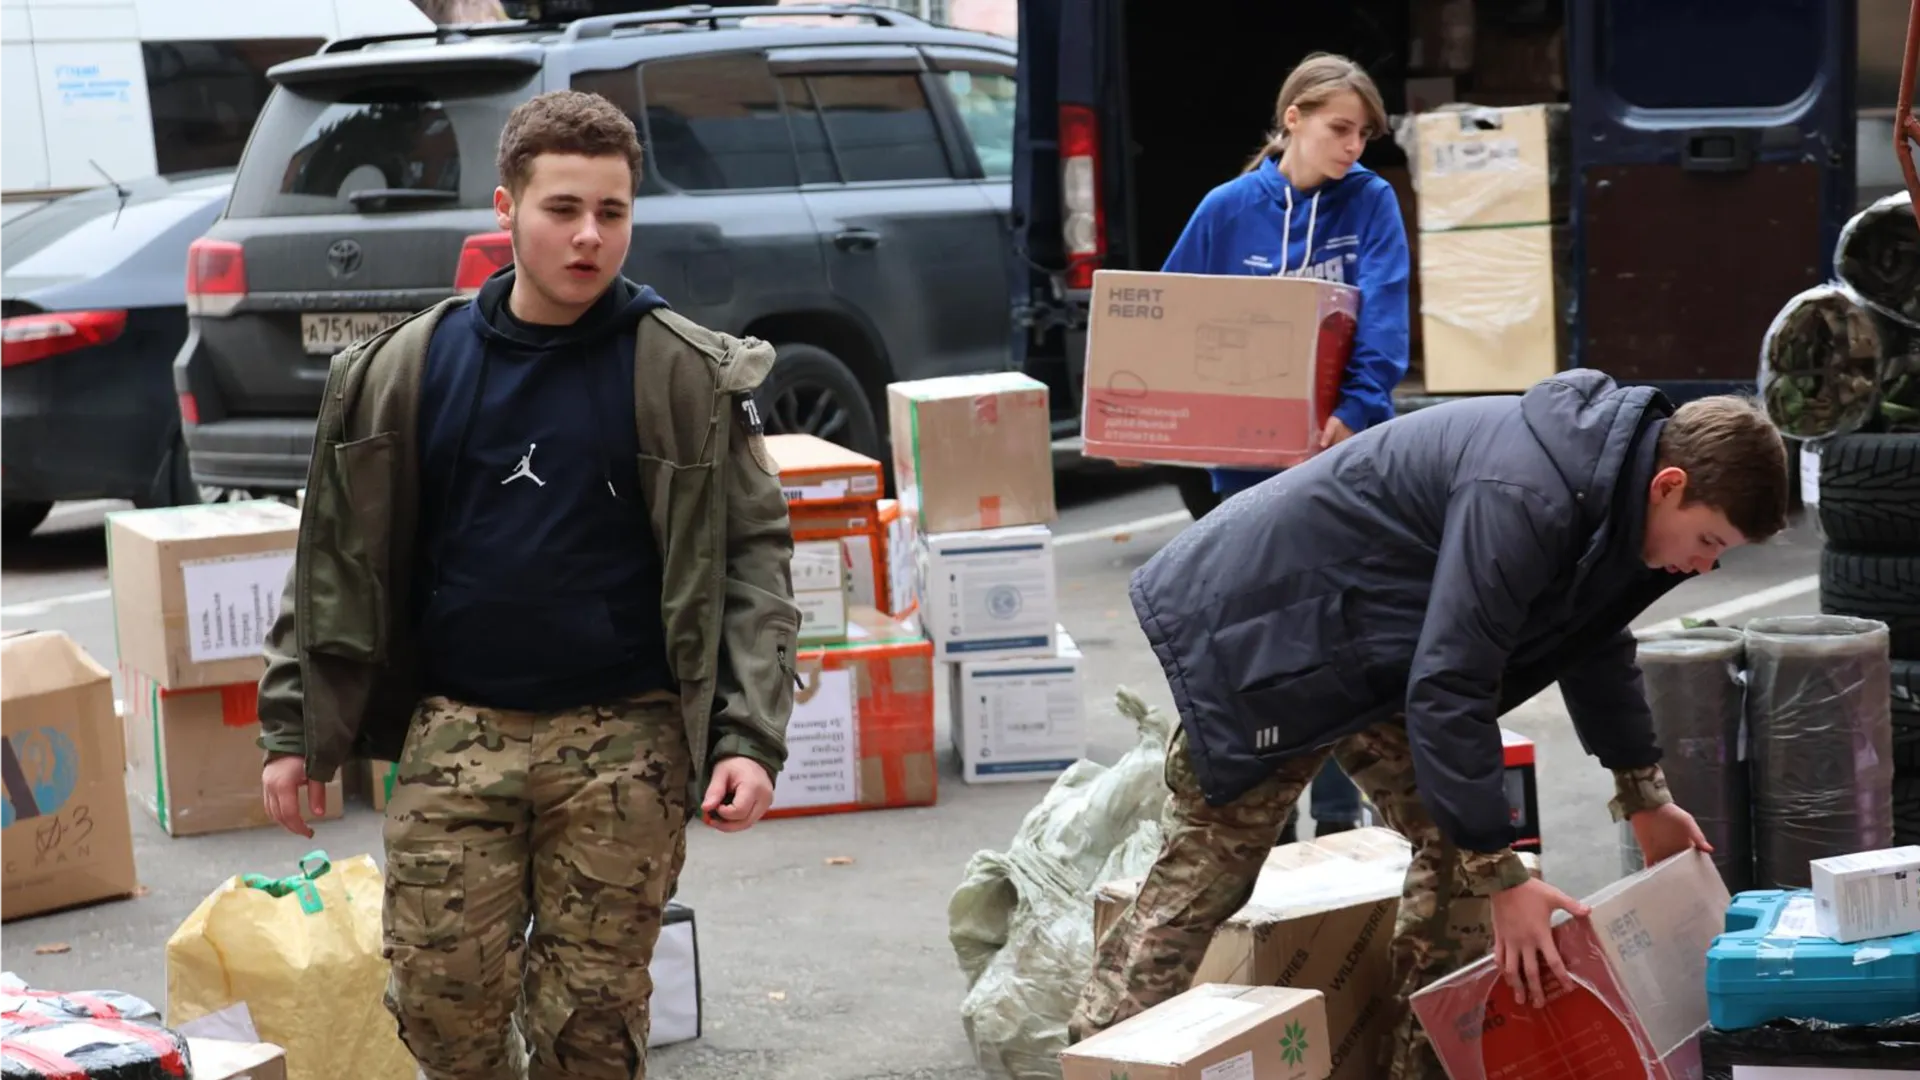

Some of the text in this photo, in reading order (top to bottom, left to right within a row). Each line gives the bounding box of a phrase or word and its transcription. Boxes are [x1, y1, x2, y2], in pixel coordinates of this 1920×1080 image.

[1109, 288, 1165, 302] HEAT
[1108, 304, 1165, 319] AERO
[1605, 908, 1642, 941] HEAT
[1329, 903, 1389, 992] WILDBERRIE
